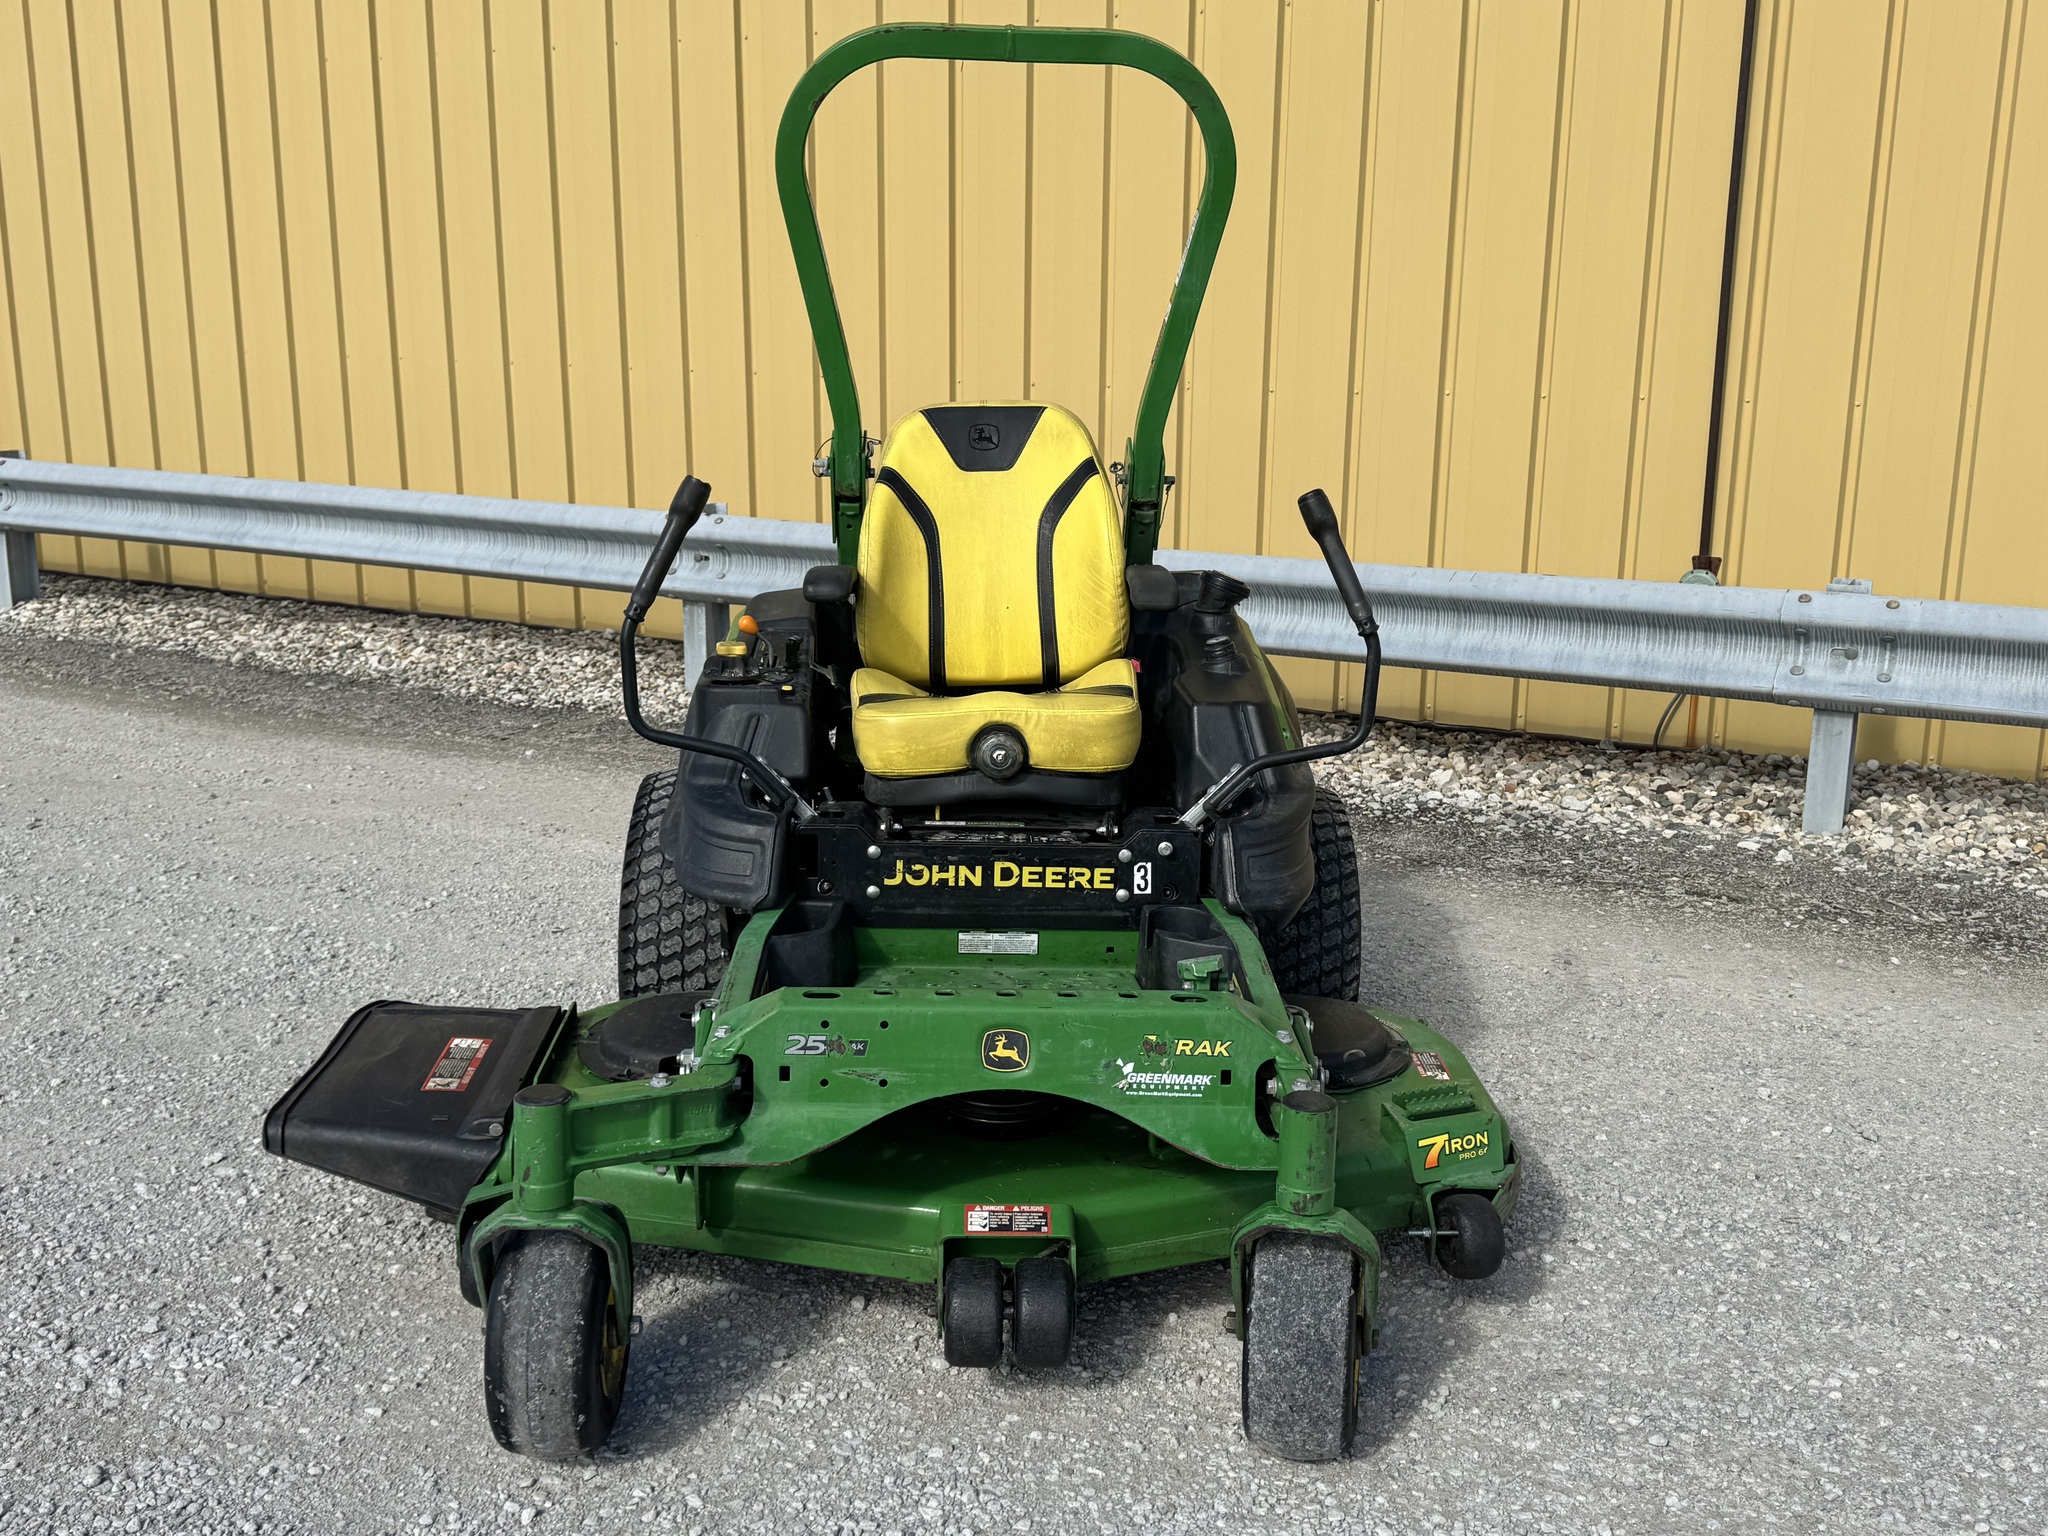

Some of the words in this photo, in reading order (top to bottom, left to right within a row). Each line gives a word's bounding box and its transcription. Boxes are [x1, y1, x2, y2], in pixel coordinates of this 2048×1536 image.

[884, 860, 982, 887] JOHN
[994, 861, 1115, 889] DEERE
[1136, 864, 1150, 892] 3
[784, 1034, 827, 1055] 25
[1174, 1039, 1232, 1056] RAK
[1127, 1072, 1212, 1086] GREENMARK
[1459, 1151, 1477, 1161] PRO
